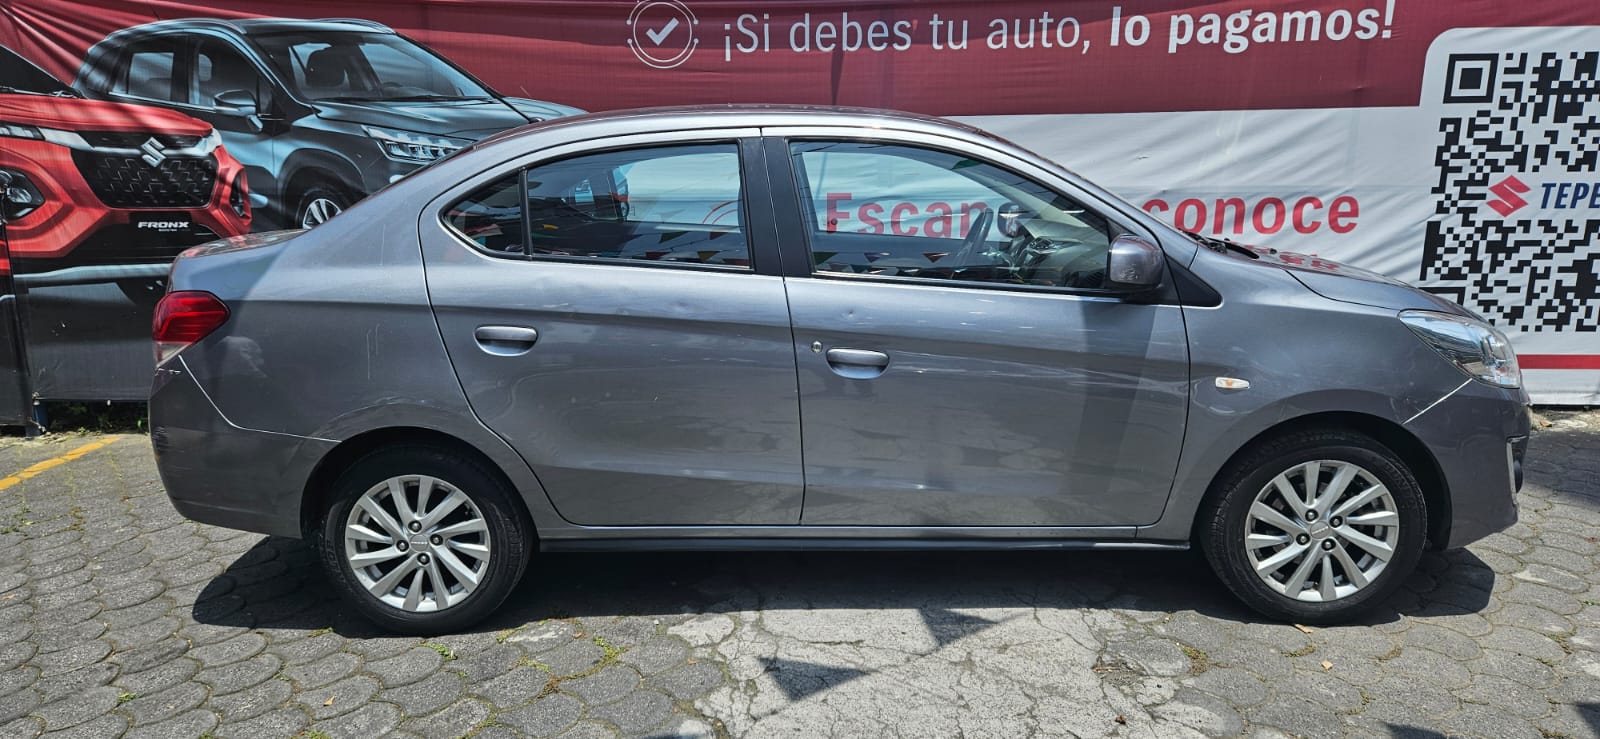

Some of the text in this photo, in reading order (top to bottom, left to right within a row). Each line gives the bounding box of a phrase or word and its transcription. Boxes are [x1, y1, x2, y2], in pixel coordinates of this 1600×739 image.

[724, 0, 1396, 62] ¡Si debes tu auto, lo pagamos!
